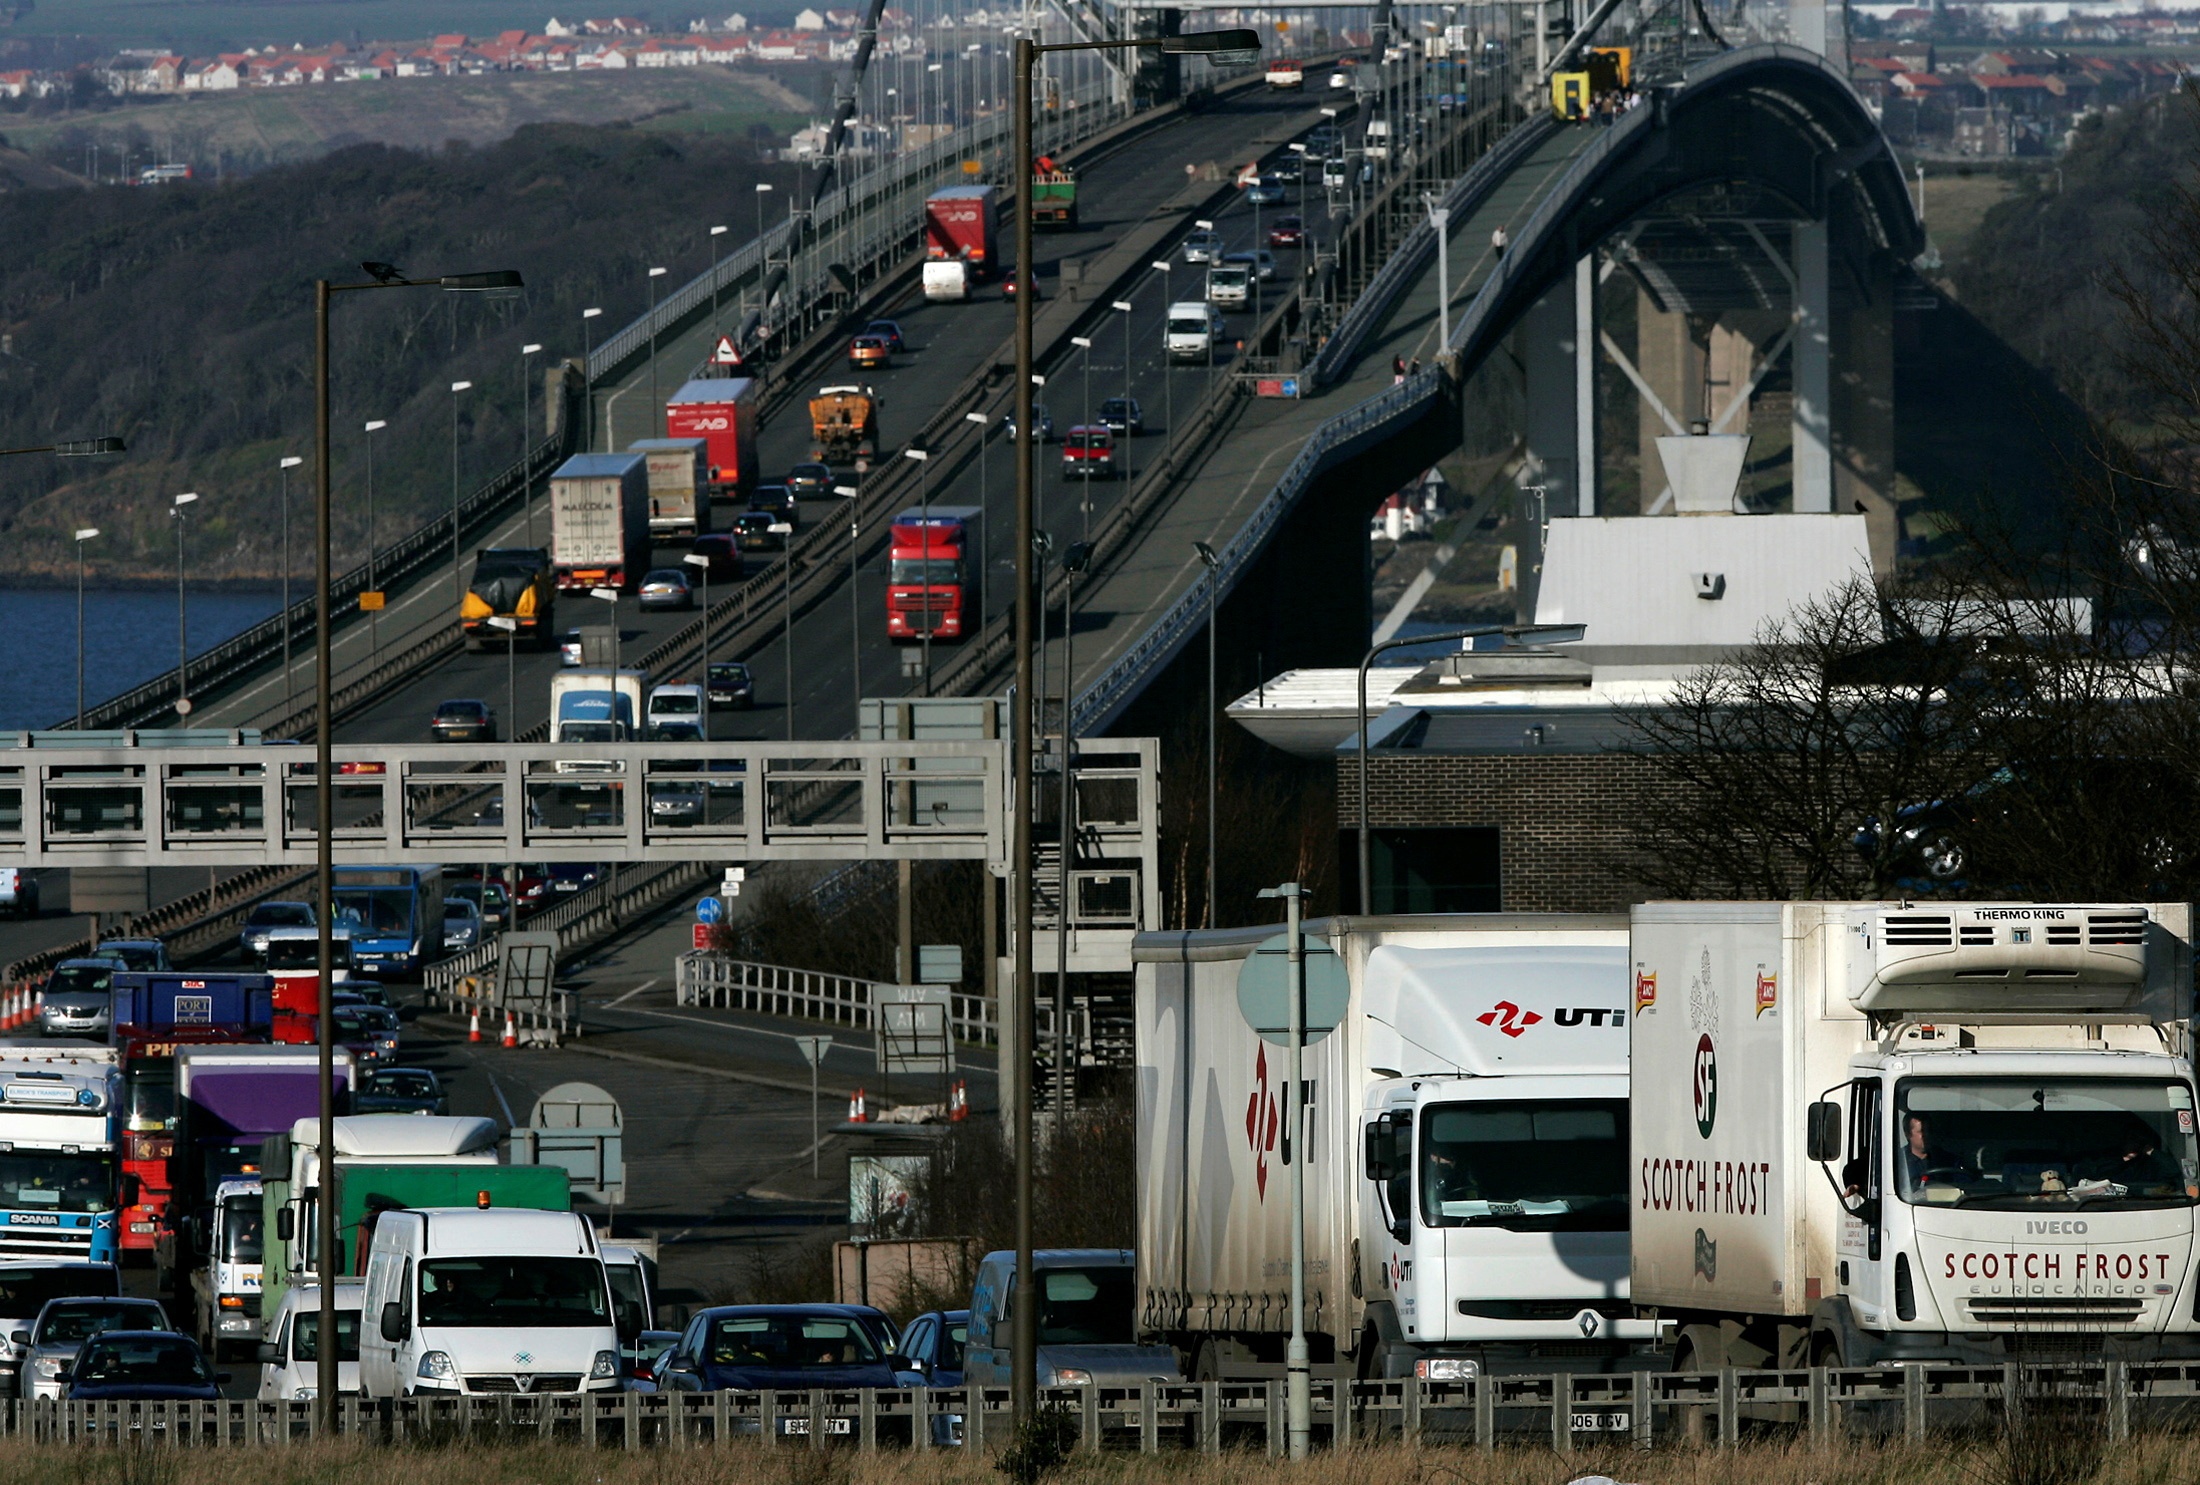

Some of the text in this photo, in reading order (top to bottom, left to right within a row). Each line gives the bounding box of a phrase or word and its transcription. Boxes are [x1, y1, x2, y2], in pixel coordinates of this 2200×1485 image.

[561, 501, 613, 512] MALCOLM
[1974, 910, 2065, 920] THERMO KING
[178, 1000, 208, 1010] PORT
[1554, 1007, 1626, 1028] UTi
[1697, 1050, 1714, 1123] SF
[1642, 1157, 1770, 1216] SCOTCH FROST
[10, 1214, 58, 1225] SCANIA
[2026, 1220, 2088, 1235] IVECO
[1945, 1252, 2170, 1279] SCOTCH FROST
[1969, 1284, 2146, 1295] EUROCARGO
